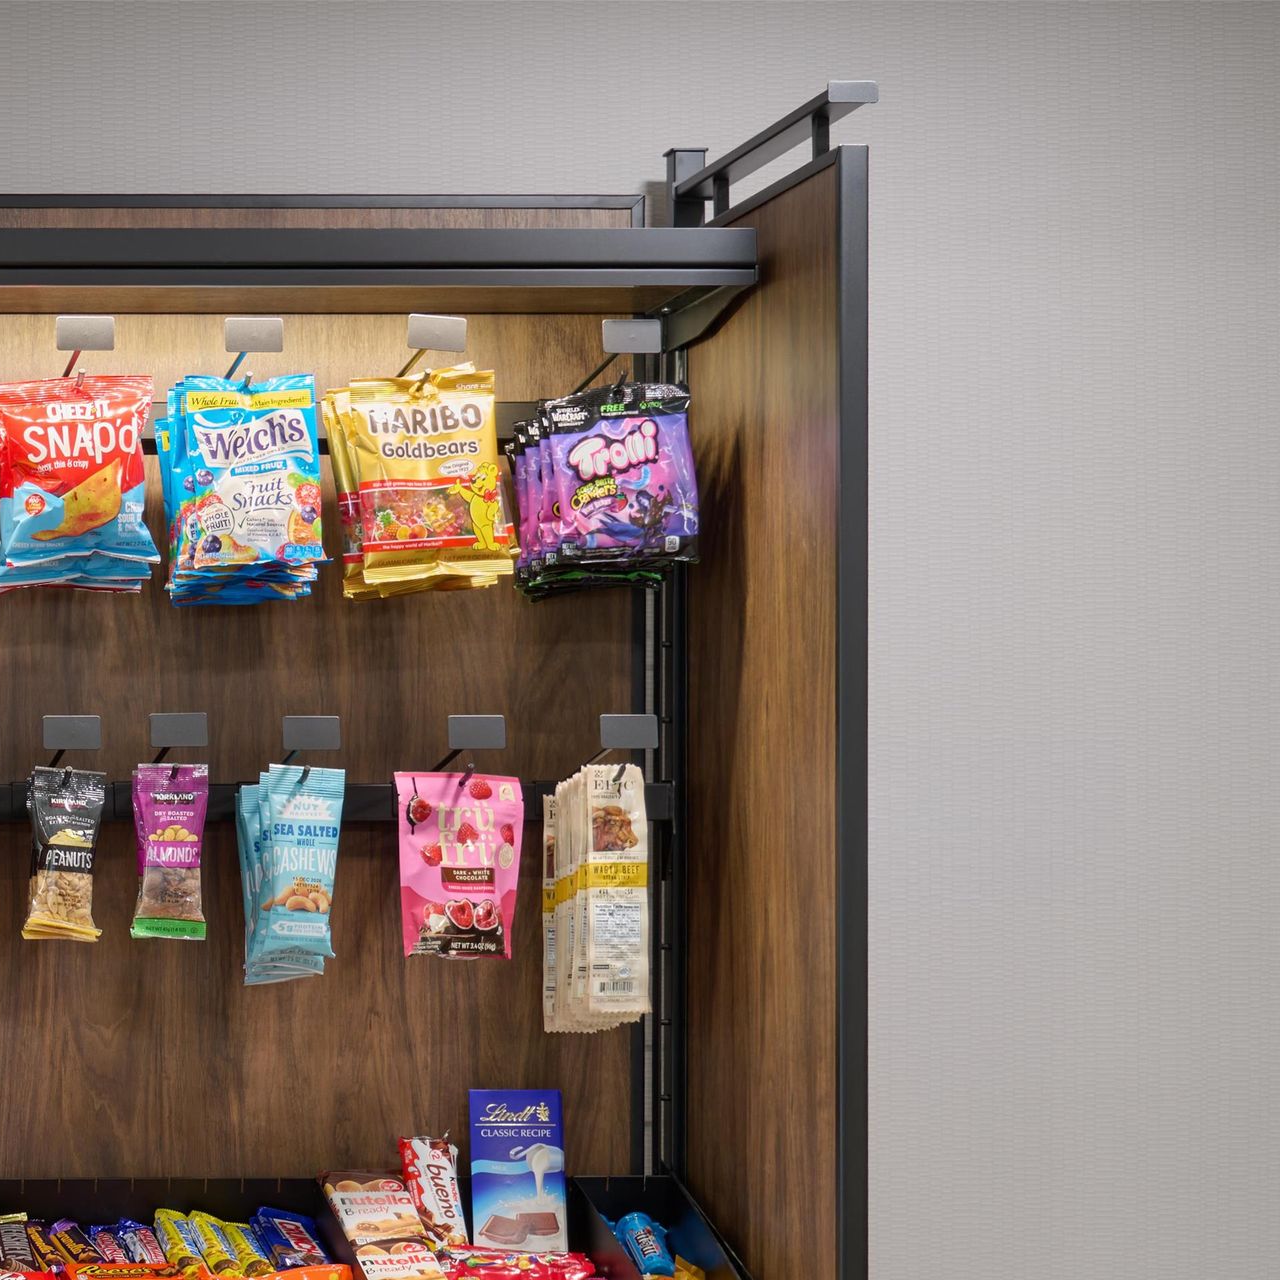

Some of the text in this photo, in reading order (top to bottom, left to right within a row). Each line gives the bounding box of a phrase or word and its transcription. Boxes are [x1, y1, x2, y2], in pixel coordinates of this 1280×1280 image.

[601, 404, 625, 412] FREE
[369, 404, 482, 434] HARIBO
[199, 414, 304, 461] Welch's
[382, 441, 478, 458] Goldbears
[569, 420, 658, 478] Trolli
[235, 460, 285, 474] MIXED FRUIT
[232, 491, 293, 511] Snacks
[293, 802, 319, 811] NUT
[436, 802, 495, 832] trü
[274, 824, 338, 837] SEA SALTED
[297, 839, 315, 847] WHOLE
[45, 849, 92, 869] PEANUTS
[273, 848, 337, 877] CASHEWS
[622, 866, 640, 874] BEEF
[480, 1103, 533, 1122] Lindt
[481, 1129, 552, 1138] CLASSIC RECIPE
[427, 1163, 456, 1219] bueno
[341, 1195, 412, 1206] nutella
[344, 1206, 389, 1216] B-ready
[361, 1255, 436, 1267] nutella
[365, 1264, 412, 1275] B-ready
